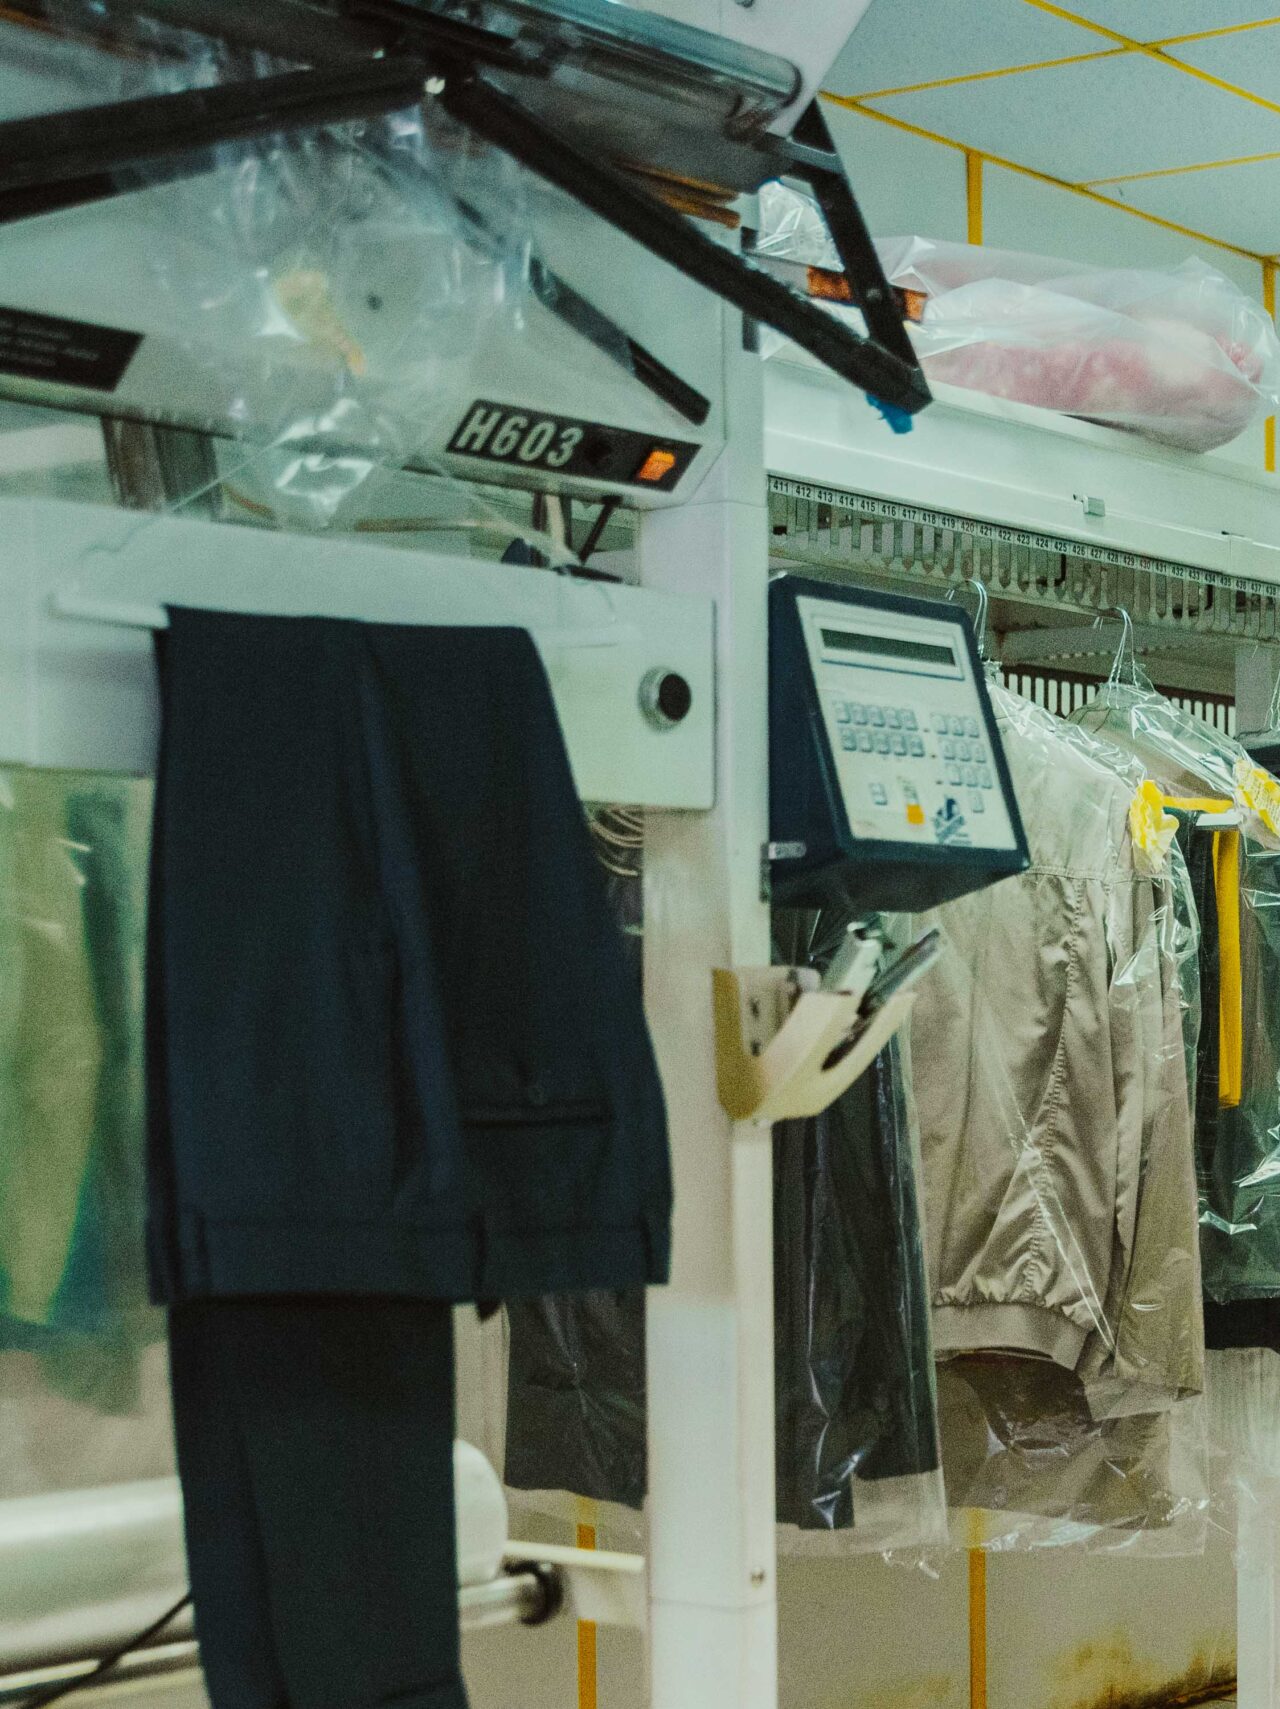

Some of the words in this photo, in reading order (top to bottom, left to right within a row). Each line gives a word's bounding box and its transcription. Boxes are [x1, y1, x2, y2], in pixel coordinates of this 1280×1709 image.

[456, 408, 584, 467] H603
[773, 480, 789, 491] 411
[796, 485, 811, 498] 412
[817, 490, 833, 503] 413
[839, 495, 854, 508] 414
[860, 500, 876, 512] 415
[881, 504, 897, 516] 416
[902, 508, 917, 520] 417
[922, 513, 936, 525] 418
[941, 518, 955, 529] 419
[960, 521, 975, 533] 420
[979, 525, 993, 536] 421
[997, 529, 1012, 541] 422
[1016, 534, 1030, 545] 423
[1035, 537, 1049, 548] 424
[1054, 541, 1068, 552] 425
[1072, 545, 1086, 556] 426
[1090, 548, 1103, 559] 427
[1171, 565, 1184, 577] 432
